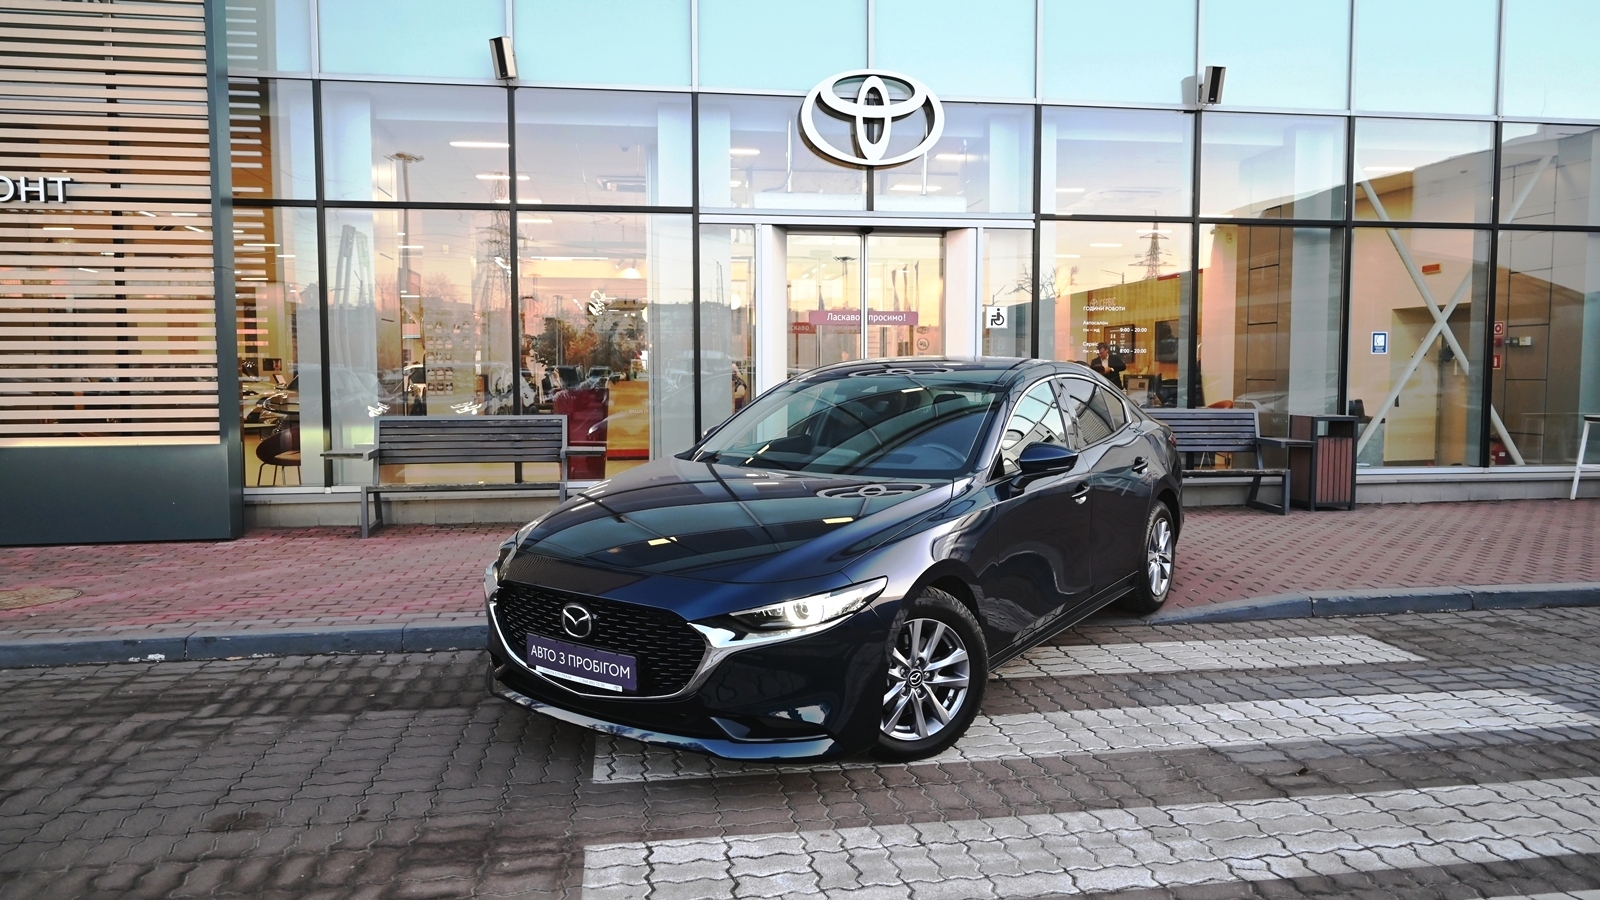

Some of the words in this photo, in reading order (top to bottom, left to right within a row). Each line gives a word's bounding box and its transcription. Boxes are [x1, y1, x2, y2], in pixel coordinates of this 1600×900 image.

[826, 312, 860, 322] Ласкаво
[868, 313, 906, 323] просимо!
[531, 645, 556, 662] АВТО
[568, 655, 630, 679] ПРОБІГОМ
